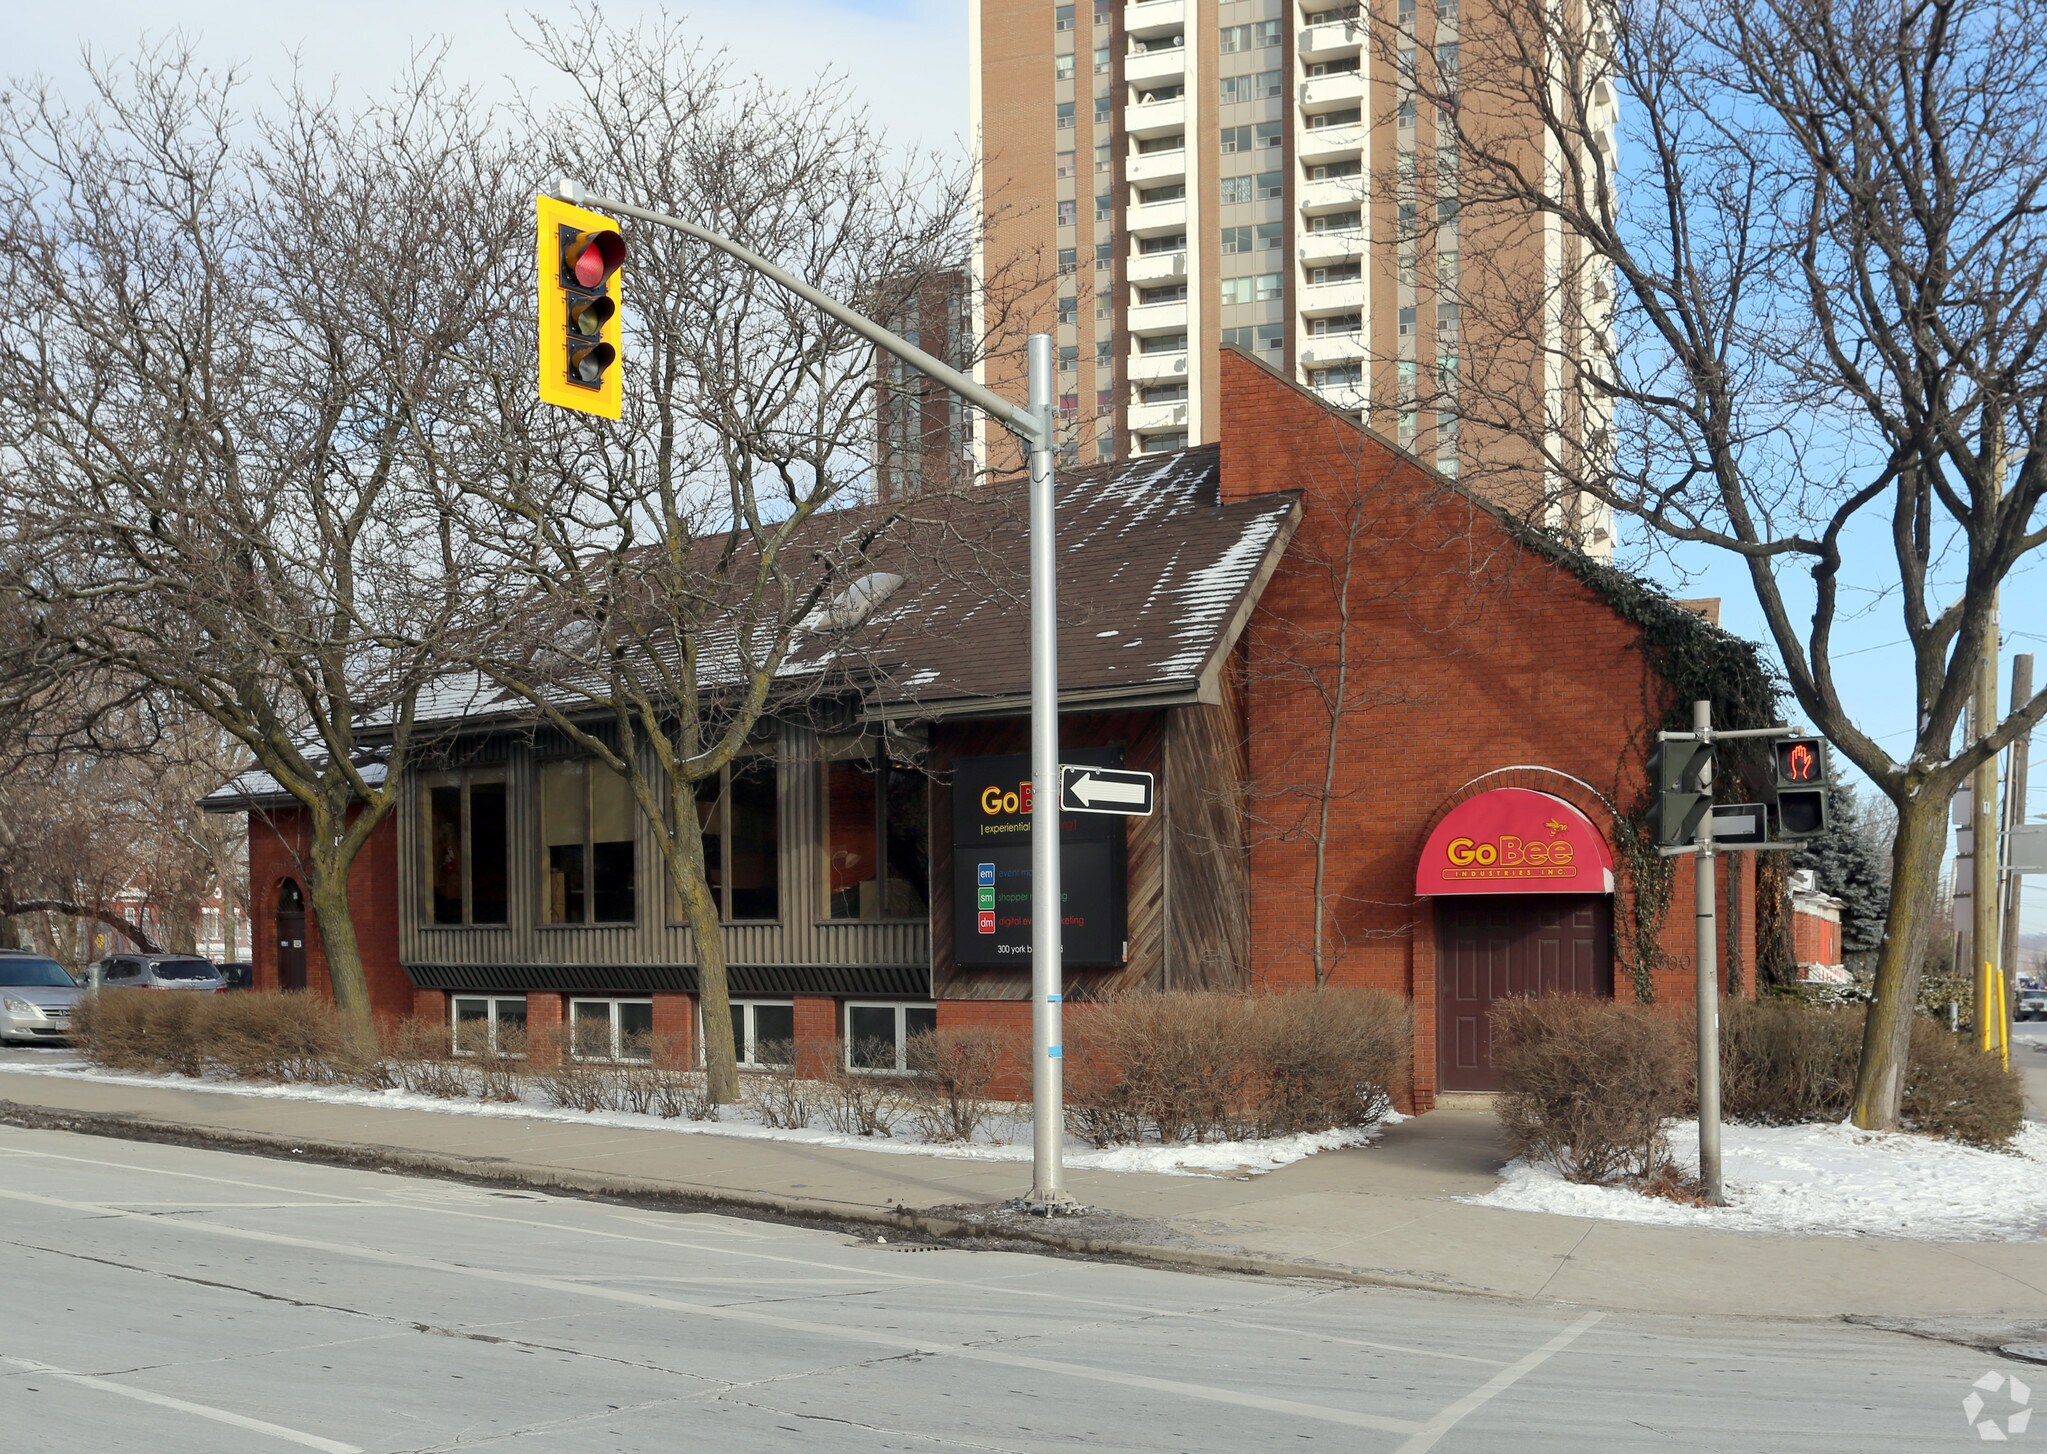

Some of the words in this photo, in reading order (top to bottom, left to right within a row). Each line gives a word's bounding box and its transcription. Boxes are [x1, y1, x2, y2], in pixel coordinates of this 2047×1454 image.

[984, 821, 1031, 834] experiential
[1447, 835, 1574, 867] GoBee
[980, 869, 993, 879] em
[1455, 869, 1531, 877] INDUSTRIES
[980, 893, 993, 903] sm
[998, 893, 1028, 903] shopper
[980, 917, 994, 928] dm
[998, 916, 1022, 927] digital
[997, 944, 1010, 954] 300
[1011, 944, 1027, 955] york
[1654, 953, 1691, 971] 300
